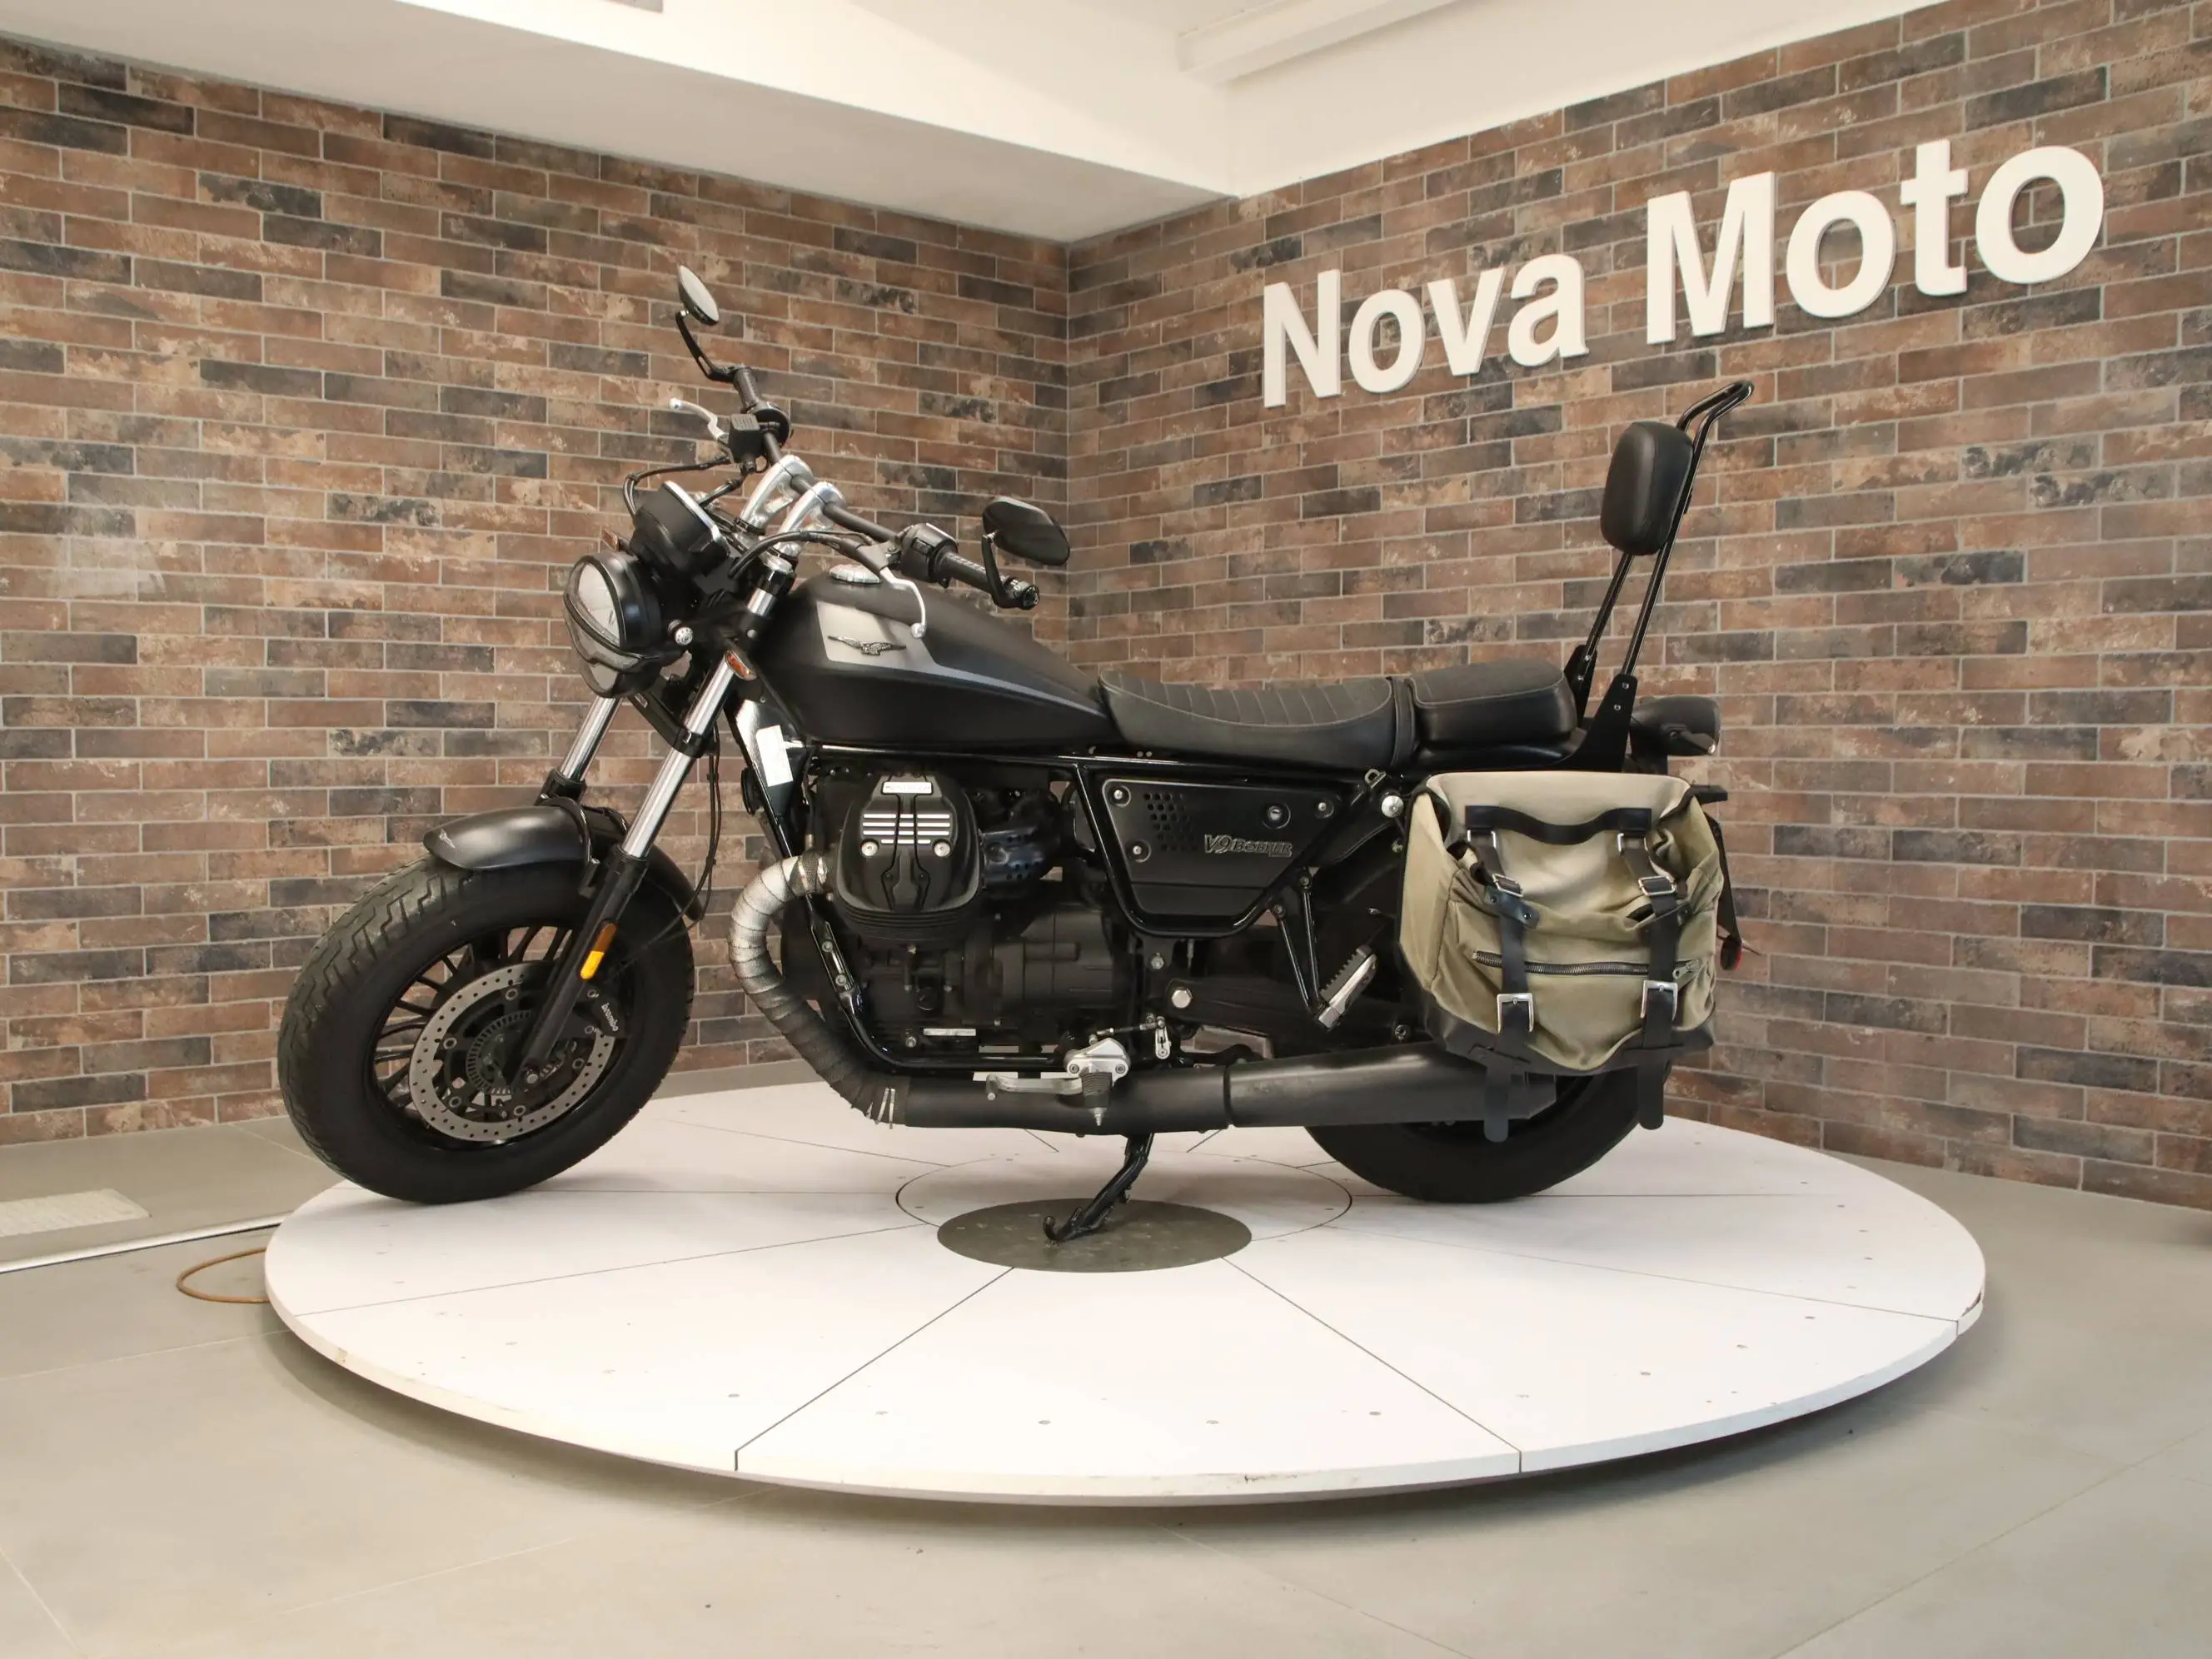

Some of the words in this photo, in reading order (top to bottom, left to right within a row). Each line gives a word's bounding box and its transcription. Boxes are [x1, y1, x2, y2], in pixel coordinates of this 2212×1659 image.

[1263, 252, 1589, 408] Nova
[1646, 138, 2105, 346] Moto
[600, 1002, 619, 1032] brembo
